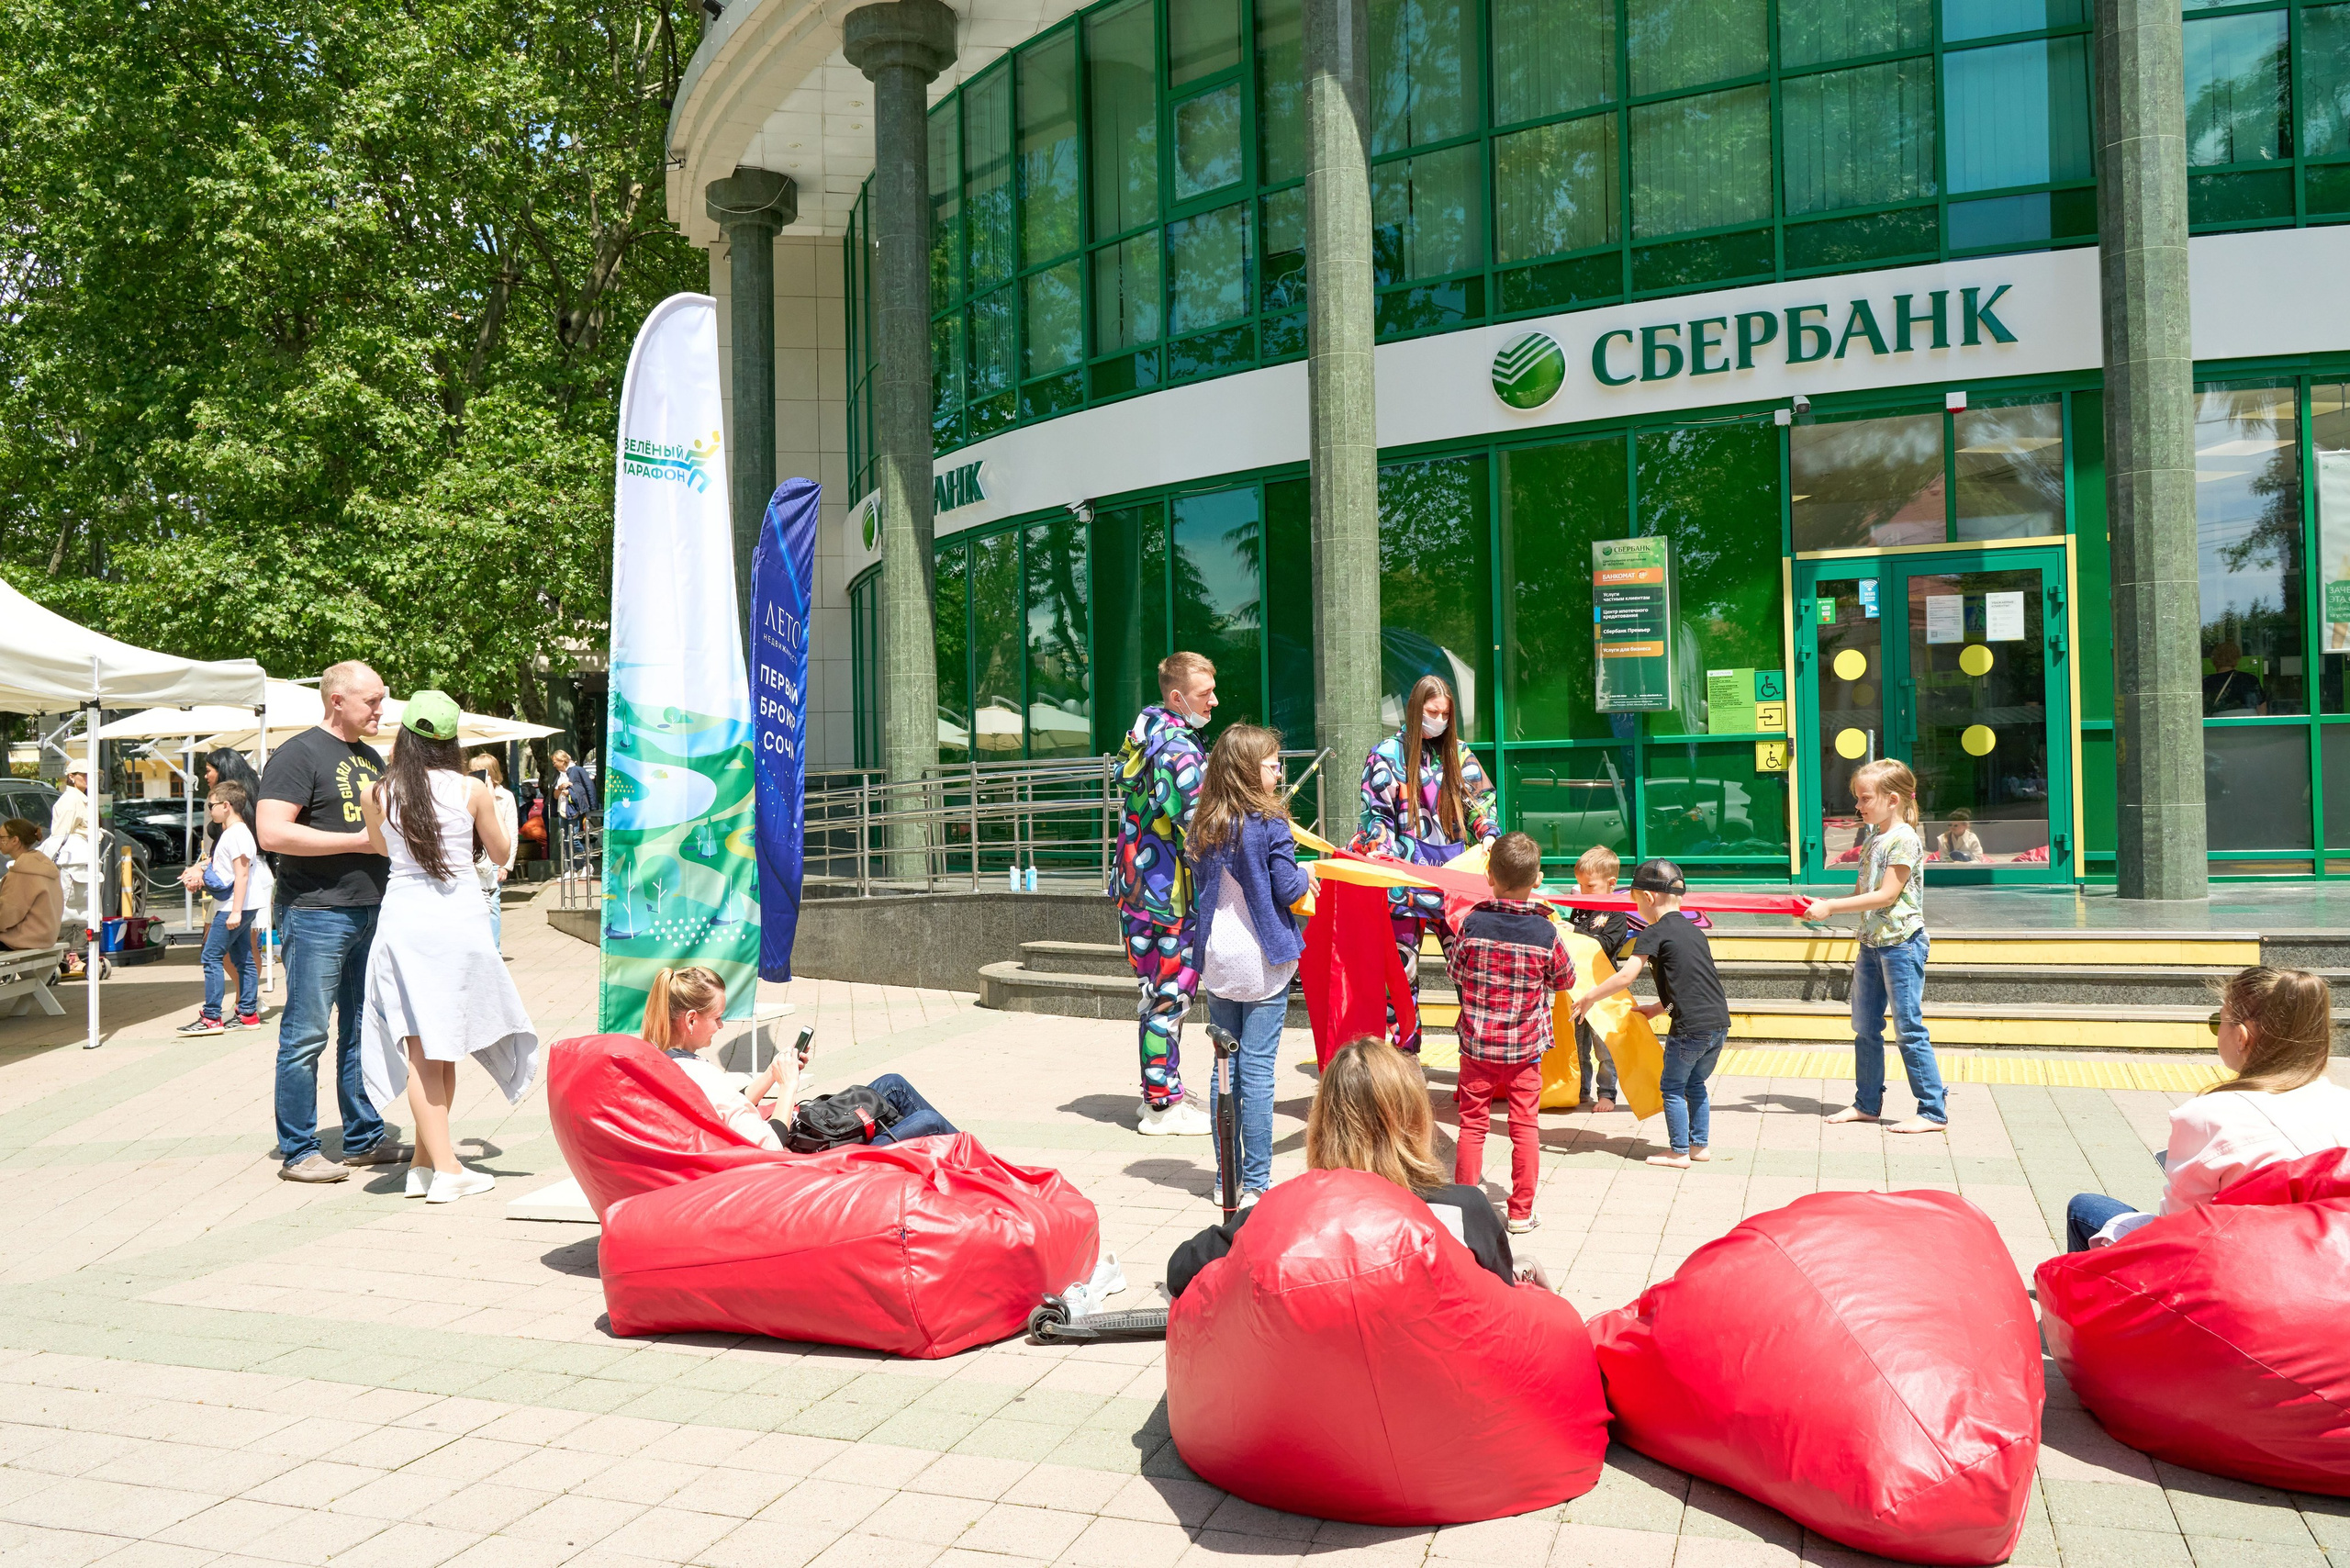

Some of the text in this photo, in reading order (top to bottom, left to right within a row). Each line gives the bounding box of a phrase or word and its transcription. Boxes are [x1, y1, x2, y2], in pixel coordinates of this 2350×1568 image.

[1592, 284, 2019, 386] СБЕРБАНК
[764, 600, 801, 649] ЛЕТО
[336, 756, 378, 799] GUARD YOUR
